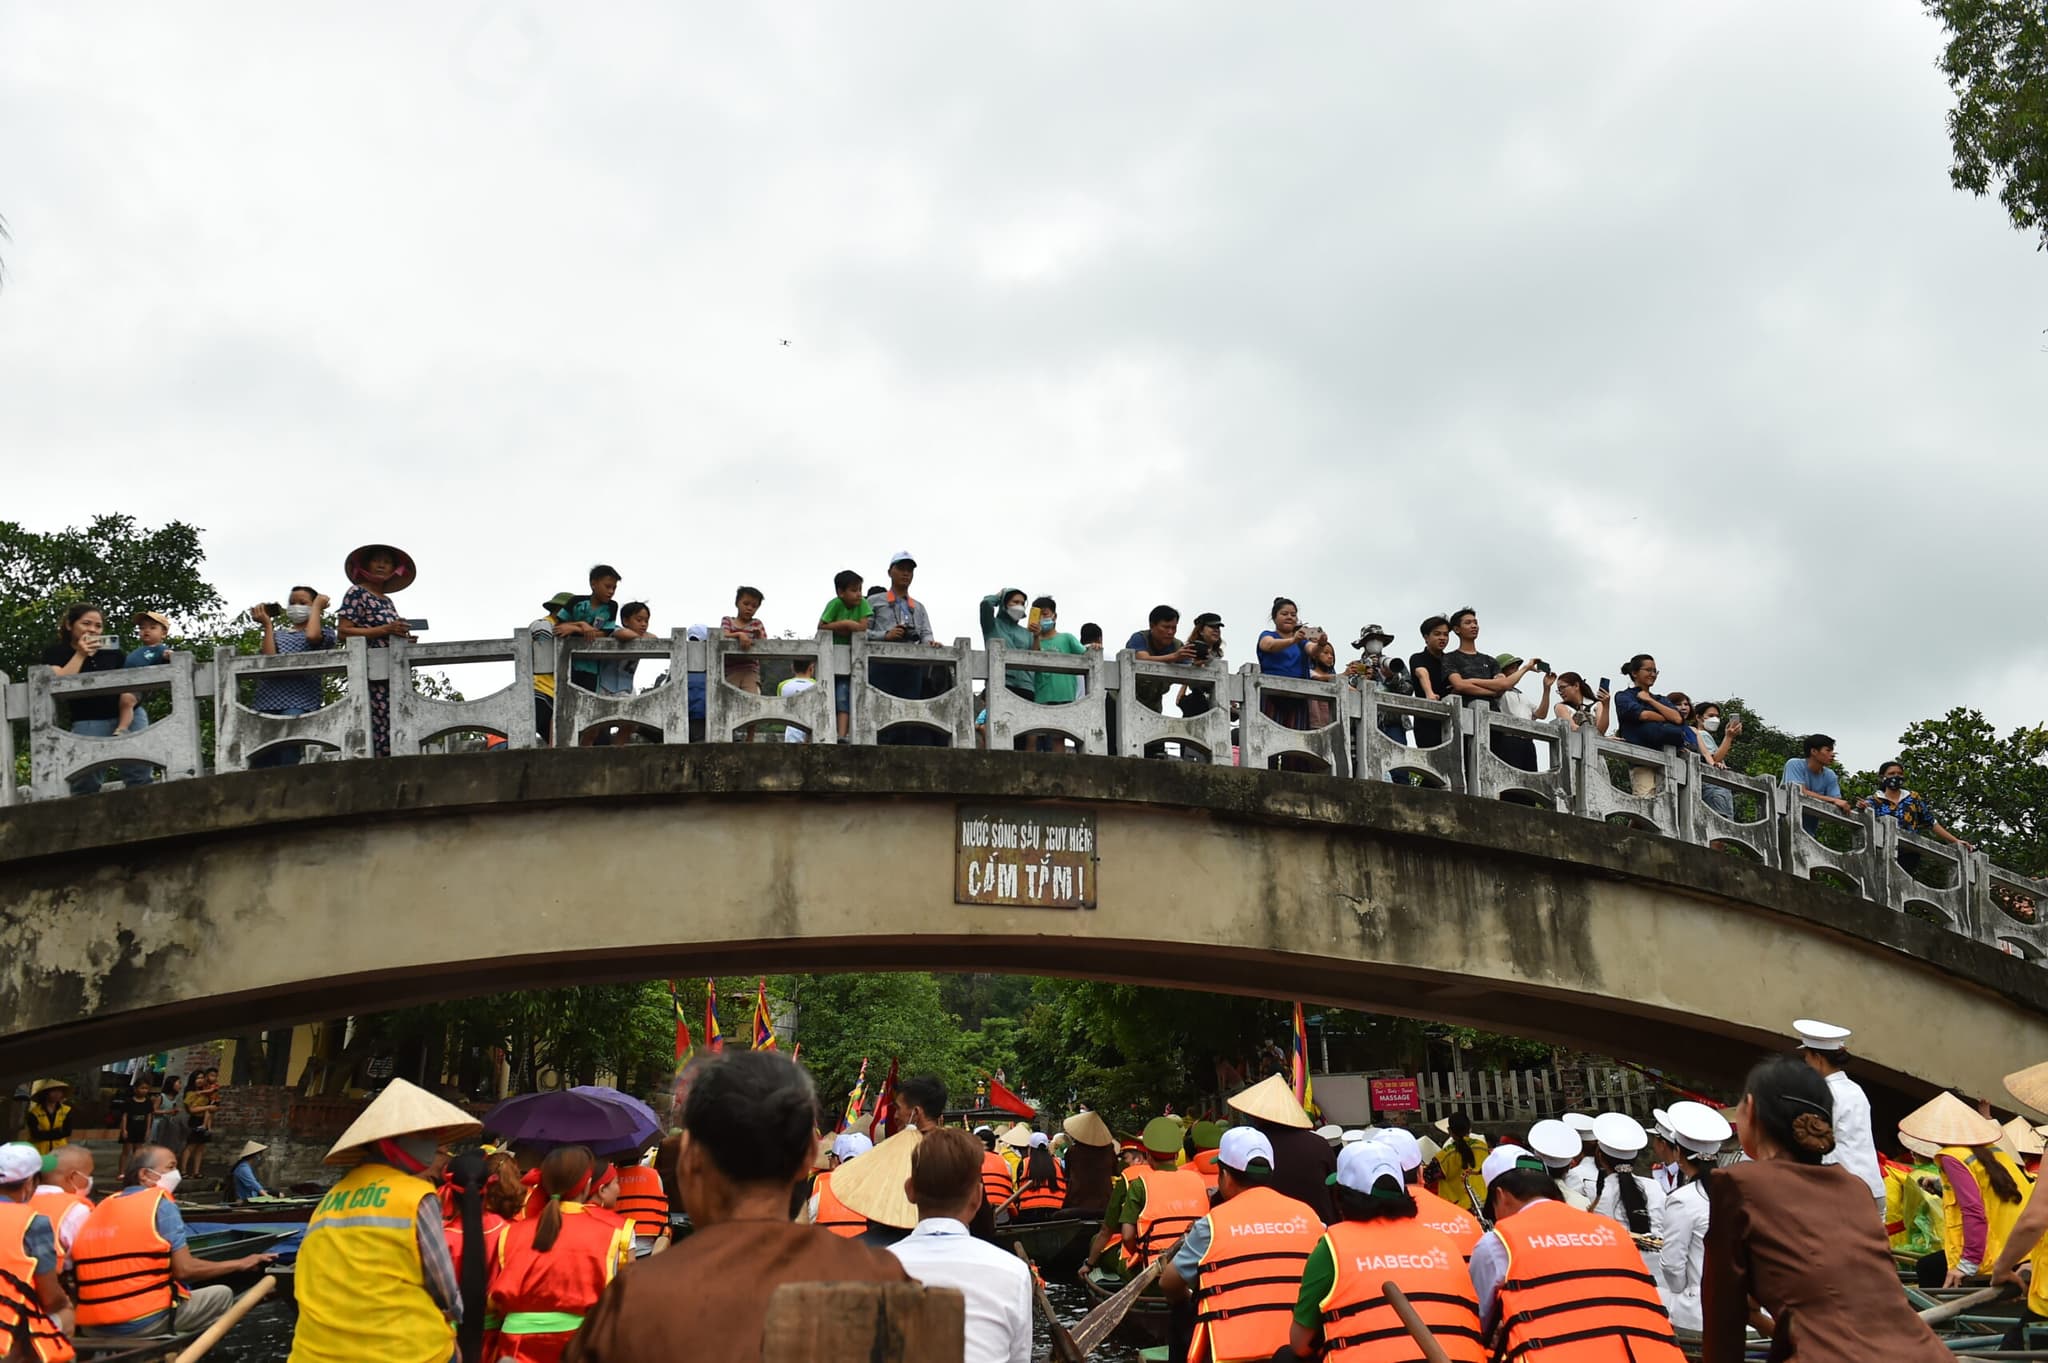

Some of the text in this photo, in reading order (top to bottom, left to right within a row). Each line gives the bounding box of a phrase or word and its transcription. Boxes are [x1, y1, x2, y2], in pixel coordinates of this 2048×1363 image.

[962, 814, 989, 847] NƯỚC
[991, 817, 1018, 849] SÔNG
[1020, 819, 1040, 850] SÂU
[968, 851, 1084, 901] CẤM TẮM !
[1379, 1093, 1410, 1102] MASSAGE
[319, 1177, 391, 1215] AM CỐC
[1230, 1222, 1295, 1237] HABECO
[1528, 1233, 1604, 1249] HABECO
[1355, 1254, 1433, 1272] HABECO
